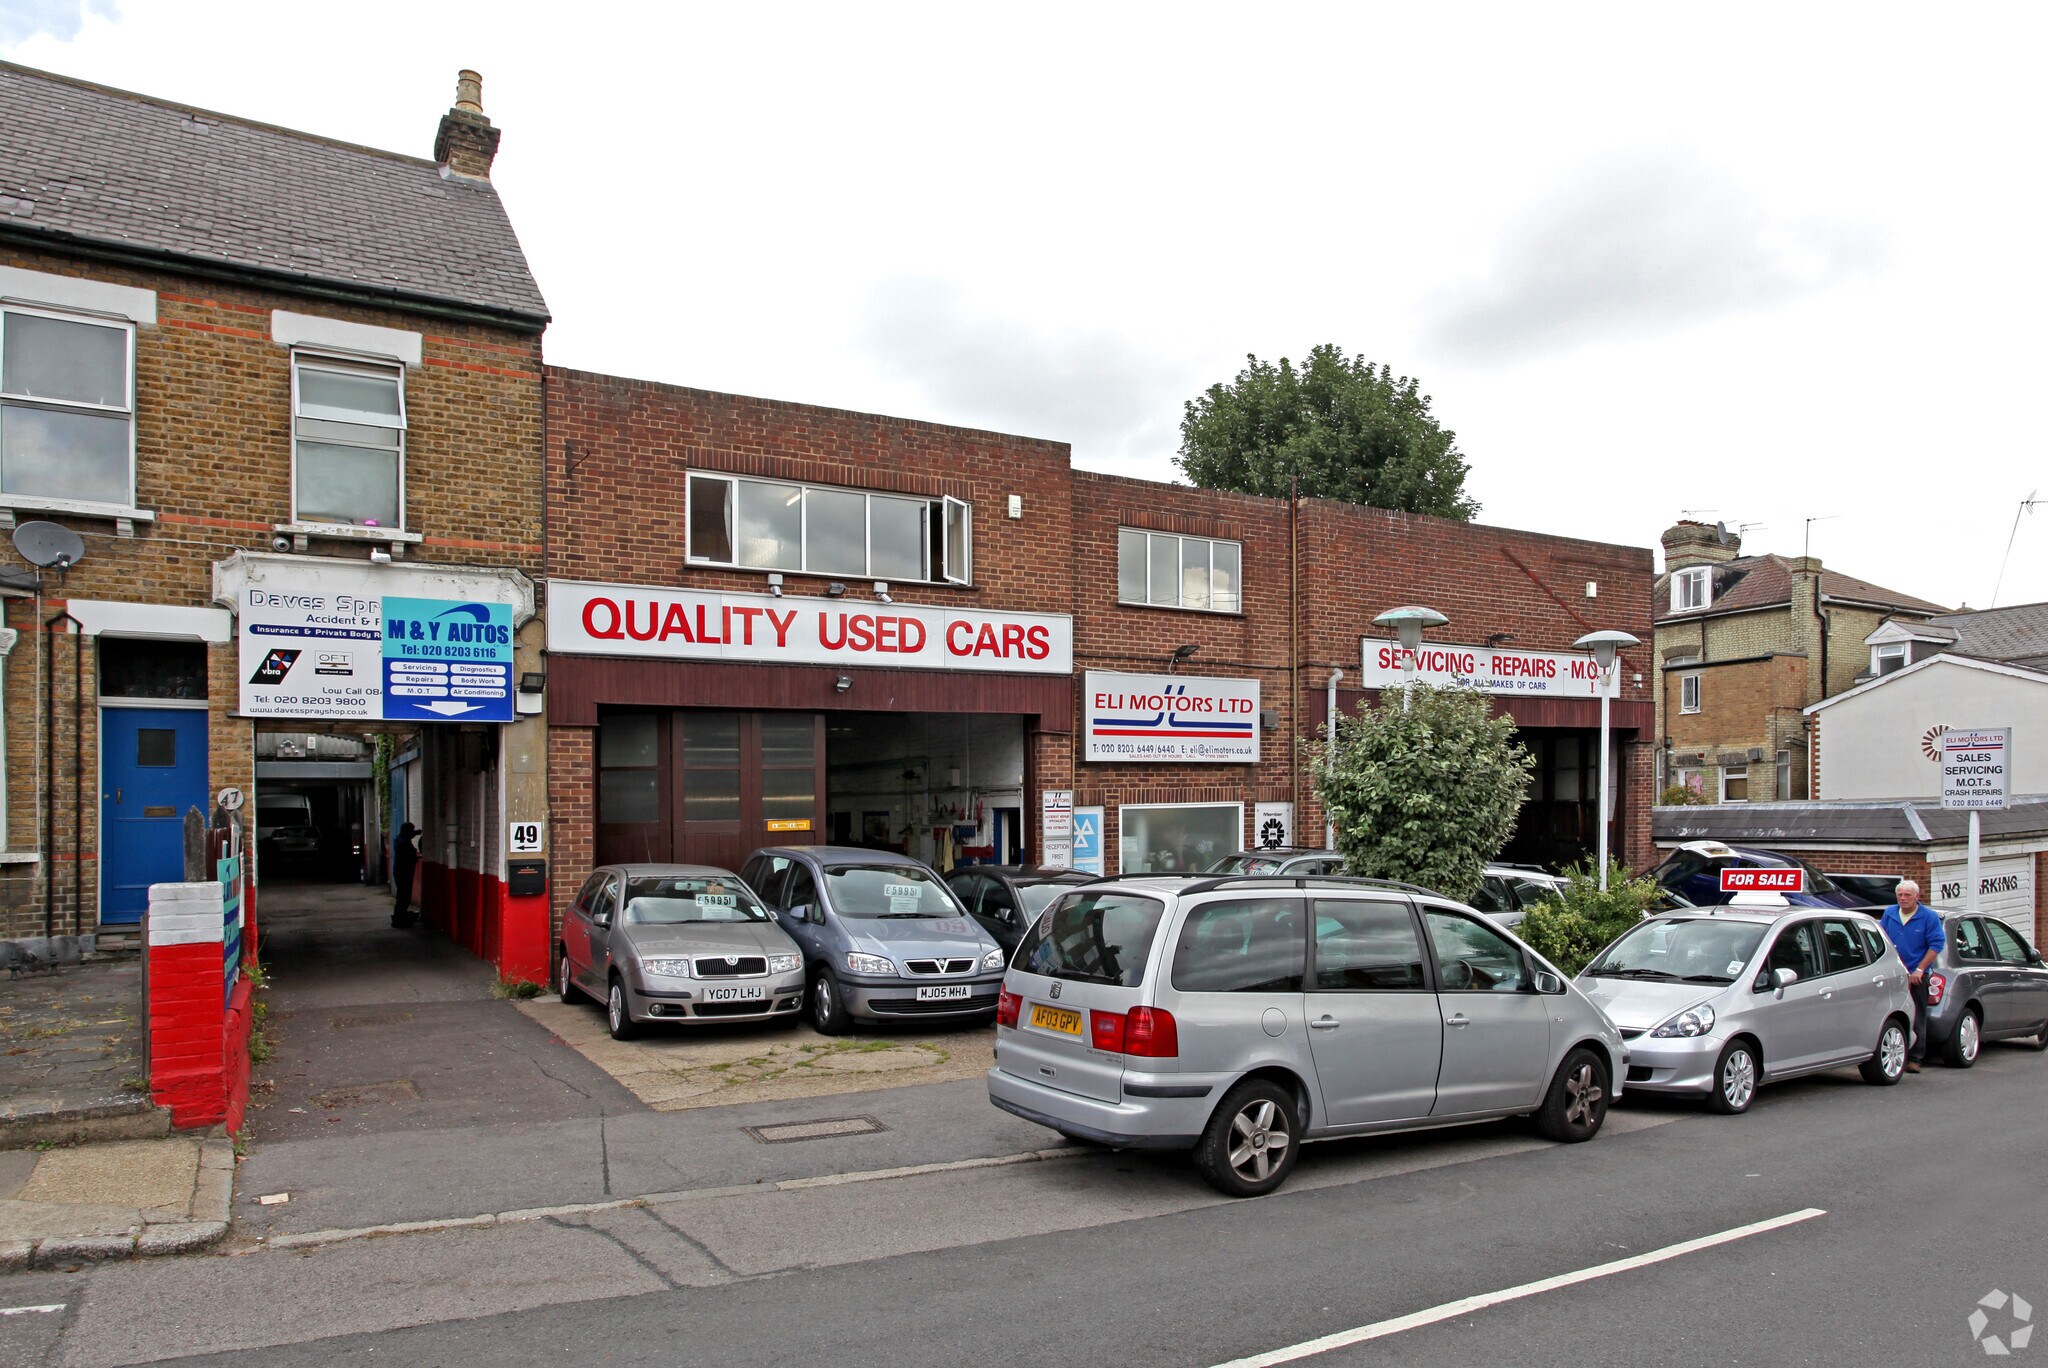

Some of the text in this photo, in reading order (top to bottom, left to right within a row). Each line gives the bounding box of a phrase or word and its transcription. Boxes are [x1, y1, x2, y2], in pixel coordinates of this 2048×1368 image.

[250, 589, 382, 616] Daves Spr
[306, 614, 356, 625] Accident
[361, 617, 370, 625] &
[257, 626, 299, 635] Insurance
[315, 629, 347, 637] Private
[350, 631, 371, 639] Body
[388, 619, 405, 639] M
[410, 620, 424, 641] &
[428, 621, 440, 641] Y
[448, 622, 508, 644] AUTOS
[581, 597, 1051, 660] QUALITY USED CARS
[401, 644, 496, 658] Tel: 020 8203 6116
[319, 654, 348, 662] OFT
[403, 664, 437, 672] Servicing
[1492, 655, 1556, 678] REPAIRS
[406, 676, 434, 684] Repairs
[1490, 680, 1513, 688] MAKES
[1517, 681, 1526, 689] OF
[1528, 681, 1546, 690] CARS
[464, 689, 504, 697] Conditioning
[254, 695, 366, 706] Tel: 020 8203 9800
[1095, 693, 1253, 713] ELI MOTORS LTD
[249, 707, 368, 716] www.davessprayshop.co.uk
[1093, 744, 1252, 756] T: 020 8203 6449/6440 E: eli@elimotors.co.uk
[1956, 753, 1991, 763] SALES
[1945, 765, 2002, 775] SERVICING
[1956, 778, 1991, 787] M.O.T.s
[1972, 788, 2002, 796] REPAIRS
[514, 825, 537, 843] 49
[1728, 874, 1795, 886] FOR SALE
[1941, 882, 1960, 899] NO
[708, 987, 761, 999] YG07 LHJ
[920, 986, 967, 998] MJ05 MHA
[1035, 1008, 1080, 1032] AF03 GPV
